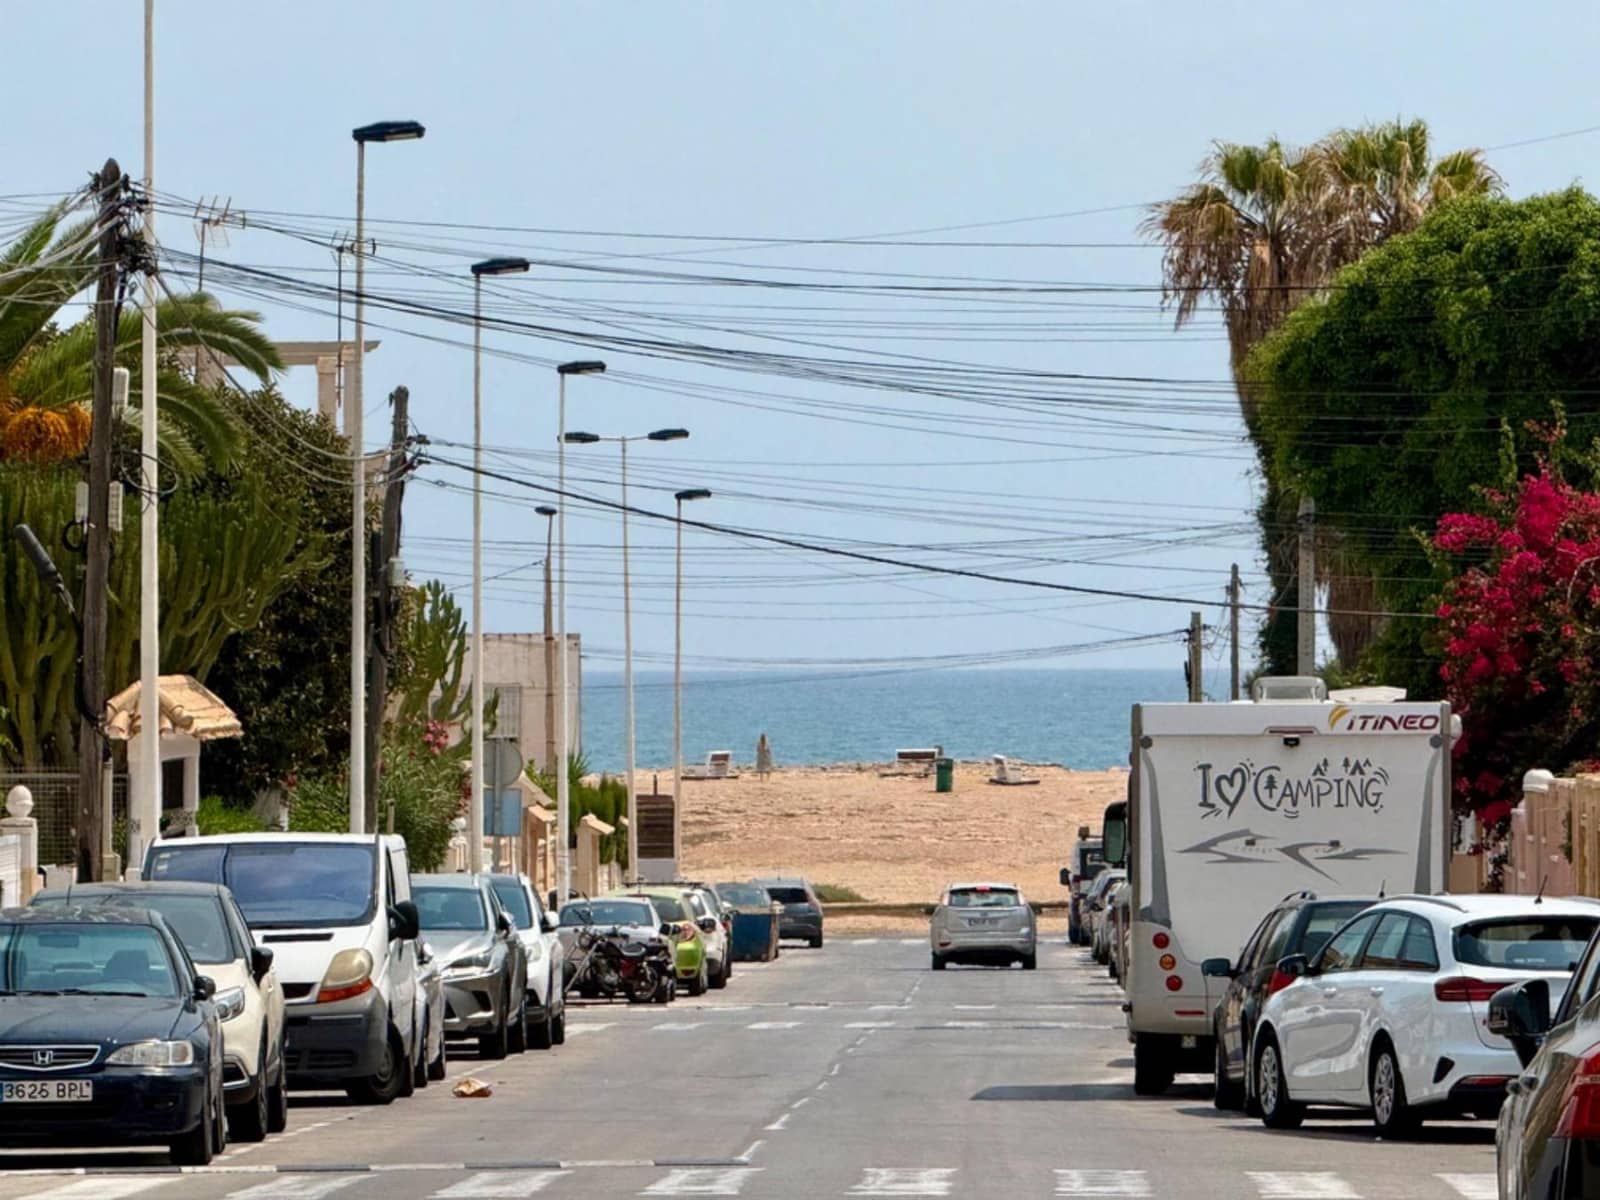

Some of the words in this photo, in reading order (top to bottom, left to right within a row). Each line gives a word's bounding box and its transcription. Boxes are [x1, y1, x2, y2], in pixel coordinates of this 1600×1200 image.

[1197, 763, 1216, 809] I
[1253, 765, 1384, 812] CAMPING
[56, 1082, 90, 1099] BPL
